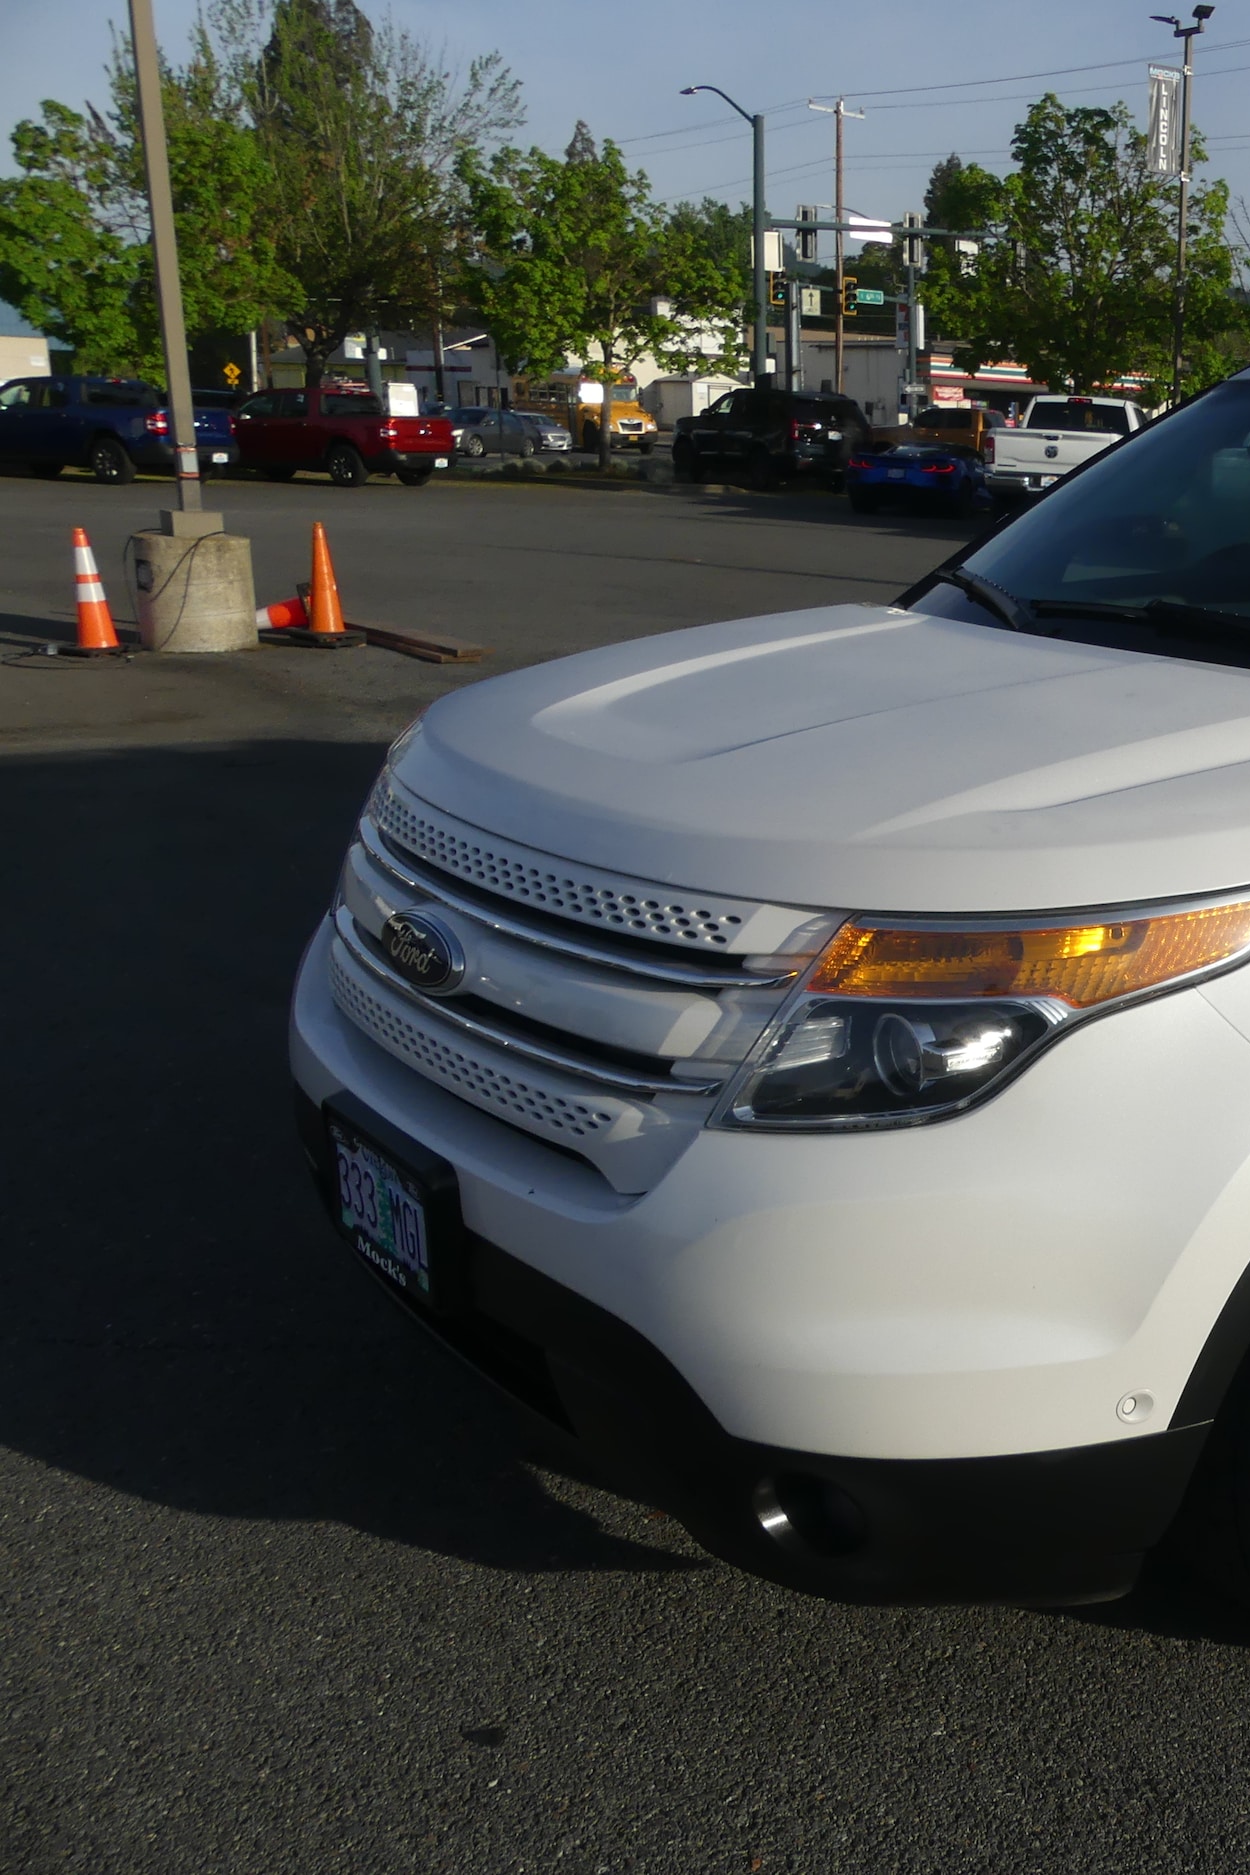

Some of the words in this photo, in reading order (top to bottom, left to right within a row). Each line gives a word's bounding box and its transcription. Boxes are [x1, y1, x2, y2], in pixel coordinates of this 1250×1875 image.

[1158, 83, 1168, 171] LINCOLN
[388, 918, 442, 974] Ford
[356, 1235, 407, 1288] Mock's
